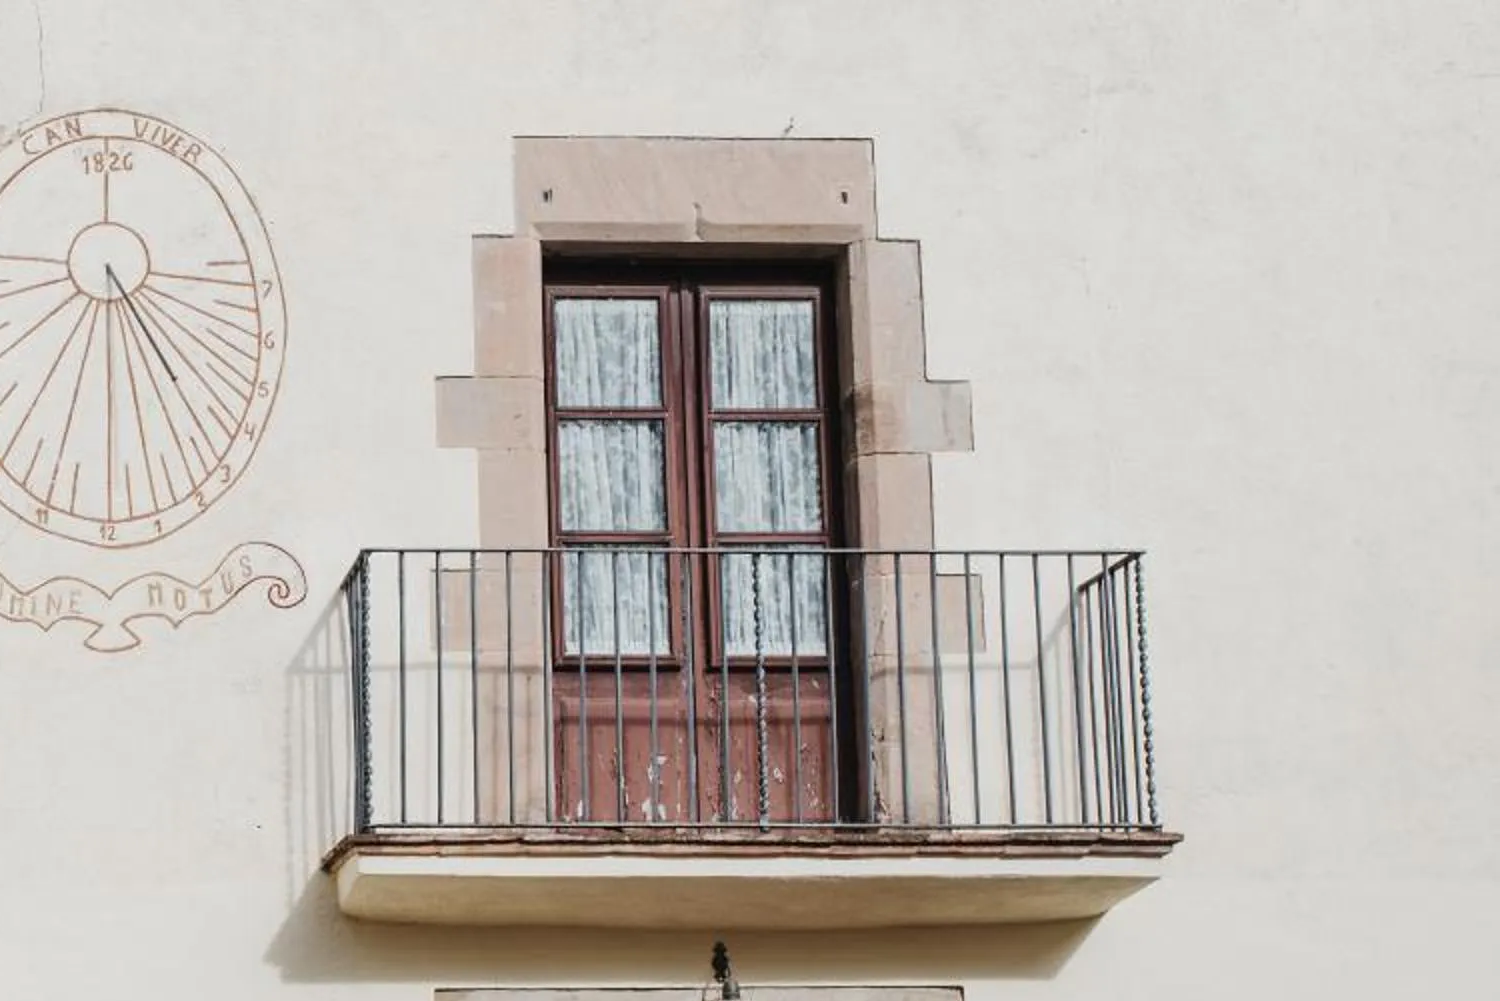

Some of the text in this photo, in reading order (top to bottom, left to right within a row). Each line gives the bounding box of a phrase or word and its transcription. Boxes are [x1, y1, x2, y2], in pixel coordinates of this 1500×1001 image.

[22, 117, 202, 164] CAN VIVER
[261, 279, 273, 300] 7
[263, 330, 275, 350] 6
[258, 381, 269, 398] 5
[244, 421, 256, 442] 4
[219, 463, 231, 483] 3
[35, 508, 49, 524] 11
[154, 518, 163, 534] 1
[99, 525, 117, 541] 12
[147, 554, 253, 611] MOTUS
